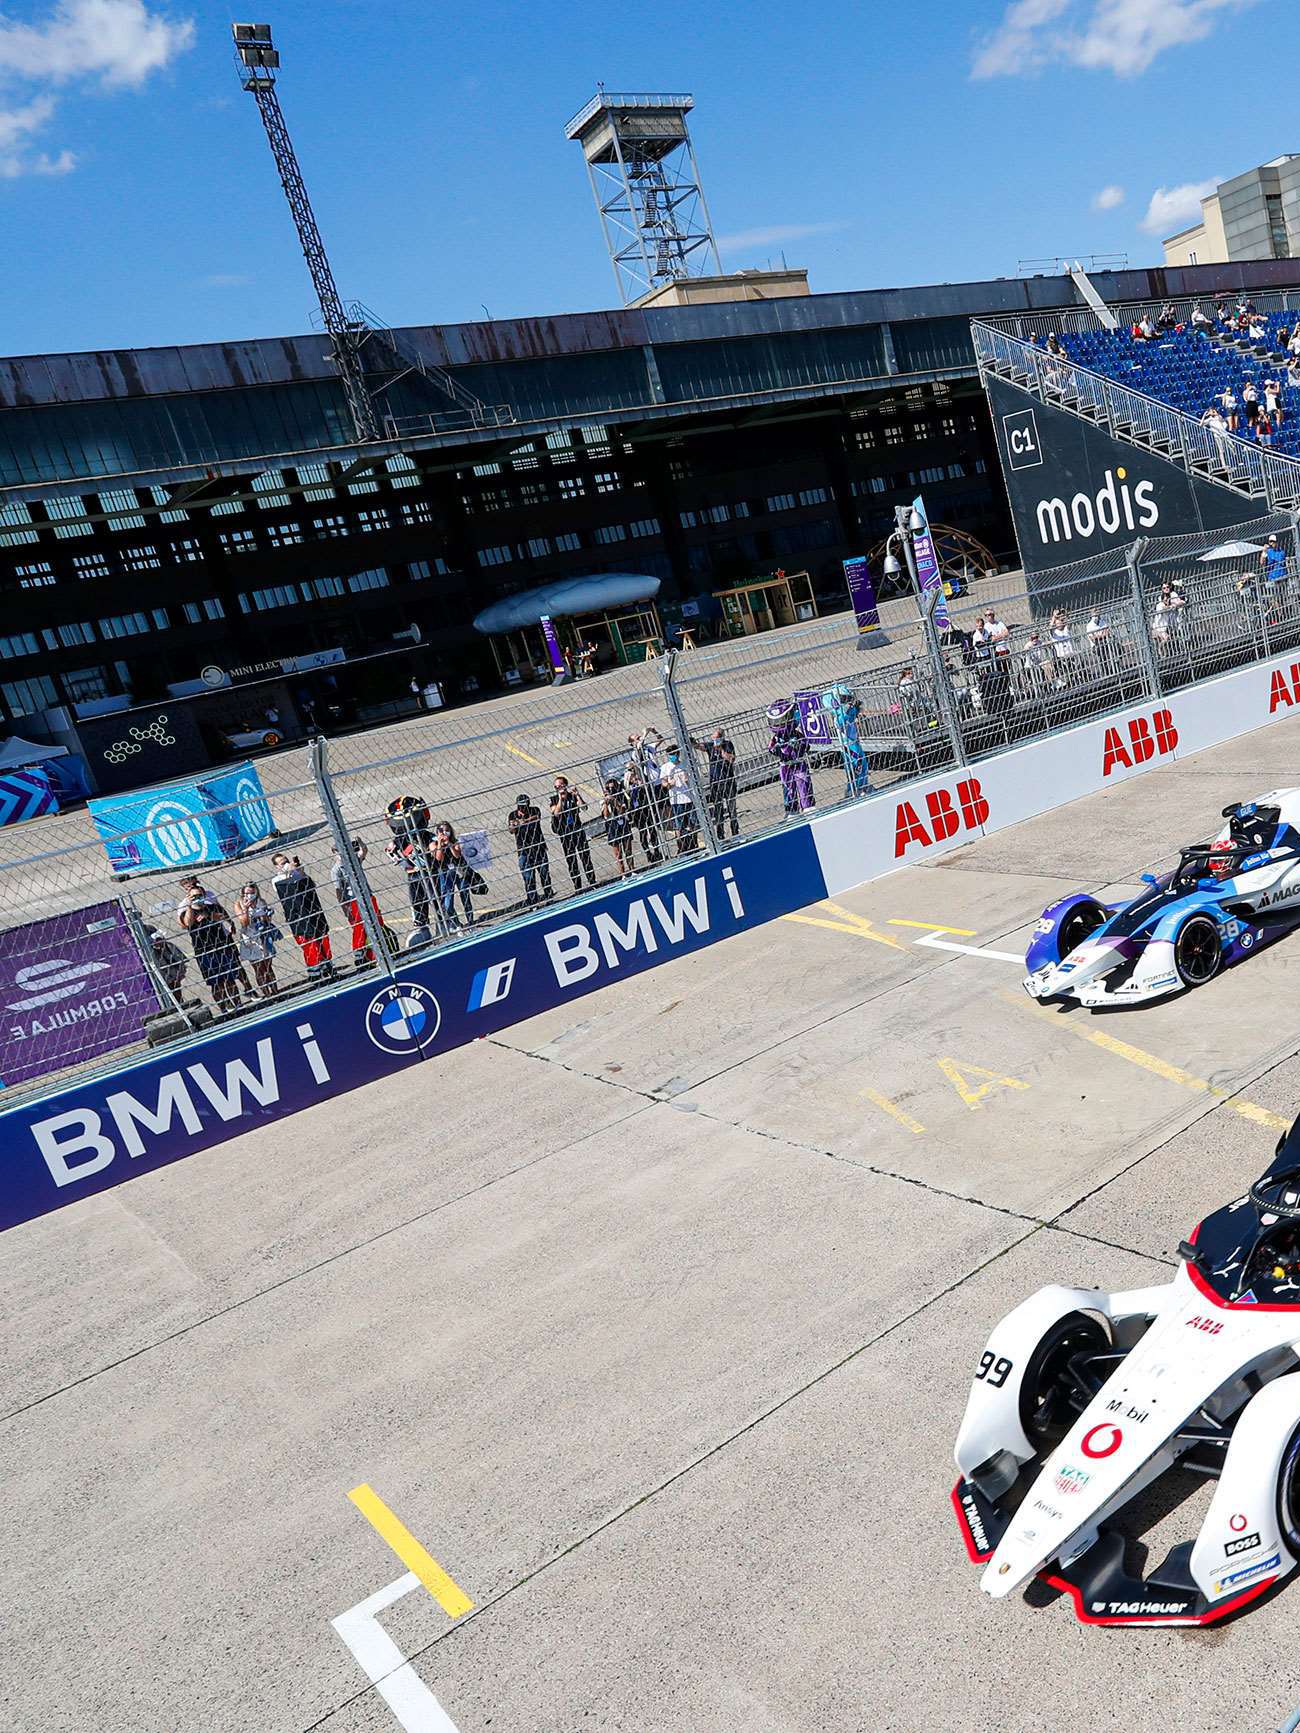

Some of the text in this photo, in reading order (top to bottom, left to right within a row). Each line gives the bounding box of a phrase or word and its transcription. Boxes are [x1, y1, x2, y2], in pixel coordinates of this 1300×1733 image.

[1010, 427, 1036, 455] C1
[1036, 466, 1160, 544] modis
[229, 665, 253, 679] MINI
[1102, 708, 1180, 777] ABB
[894, 777, 991, 859] ABB
[544, 866, 745, 988] BMW i
[30, 1022, 331, 1188] BMW i
[1185, 1315, 1225, 1335] ABB
[975, 1350, 1014, 1389] 99
[1226, 1535, 1260, 1555] BOSS
[1233, 1559, 1279, 1584] MICHELIN
